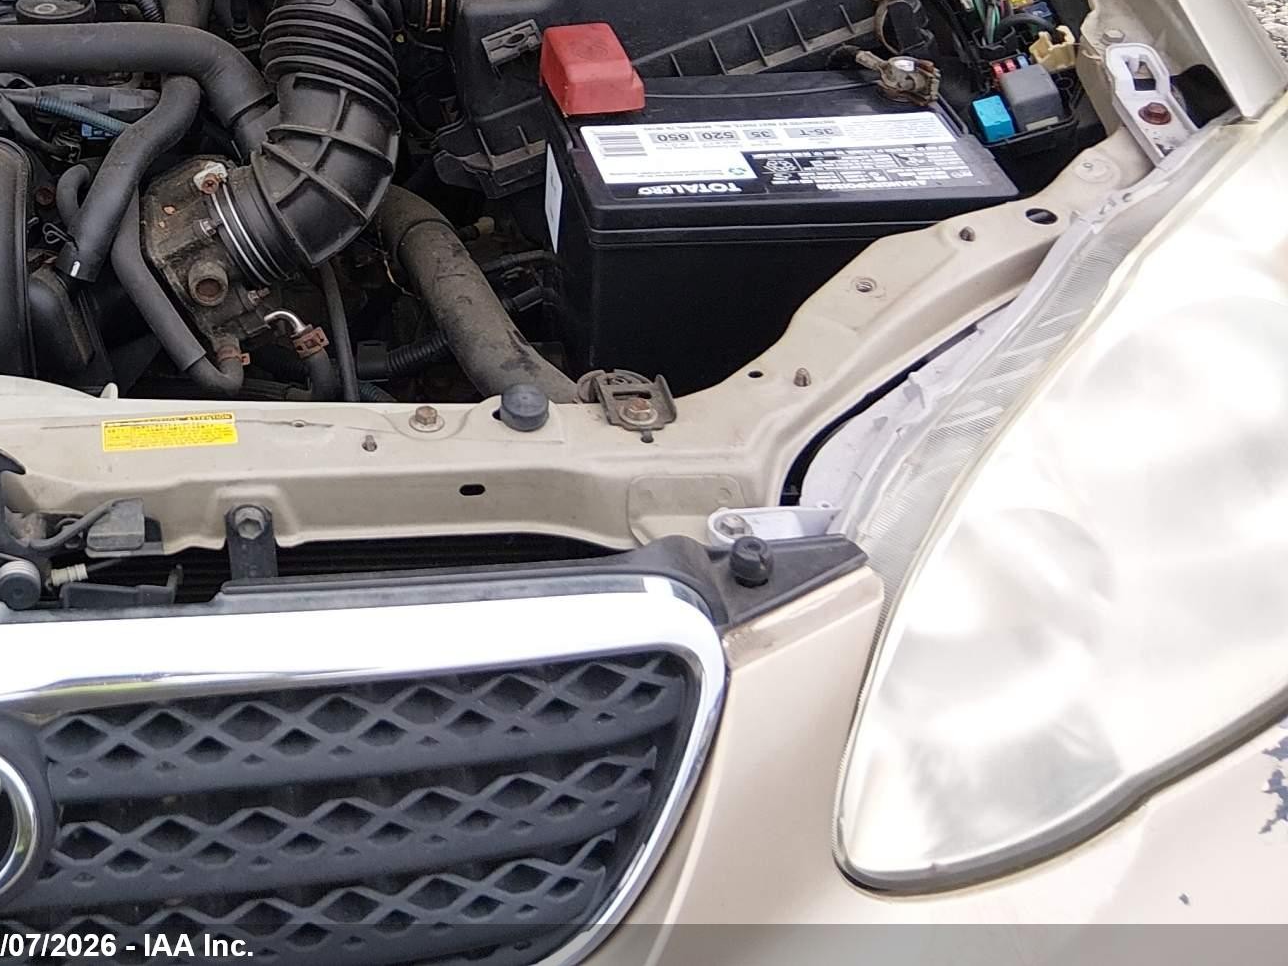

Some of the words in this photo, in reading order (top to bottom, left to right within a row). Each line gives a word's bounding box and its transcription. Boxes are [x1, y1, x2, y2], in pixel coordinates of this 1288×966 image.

[657, 131, 690, 143] 650
[701, 130, 735, 141] 520
[747, 128, 771, 139] 35
[797, 127, 836, 138] 35-T
[637, 183, 743, 196] TOTALPRO
